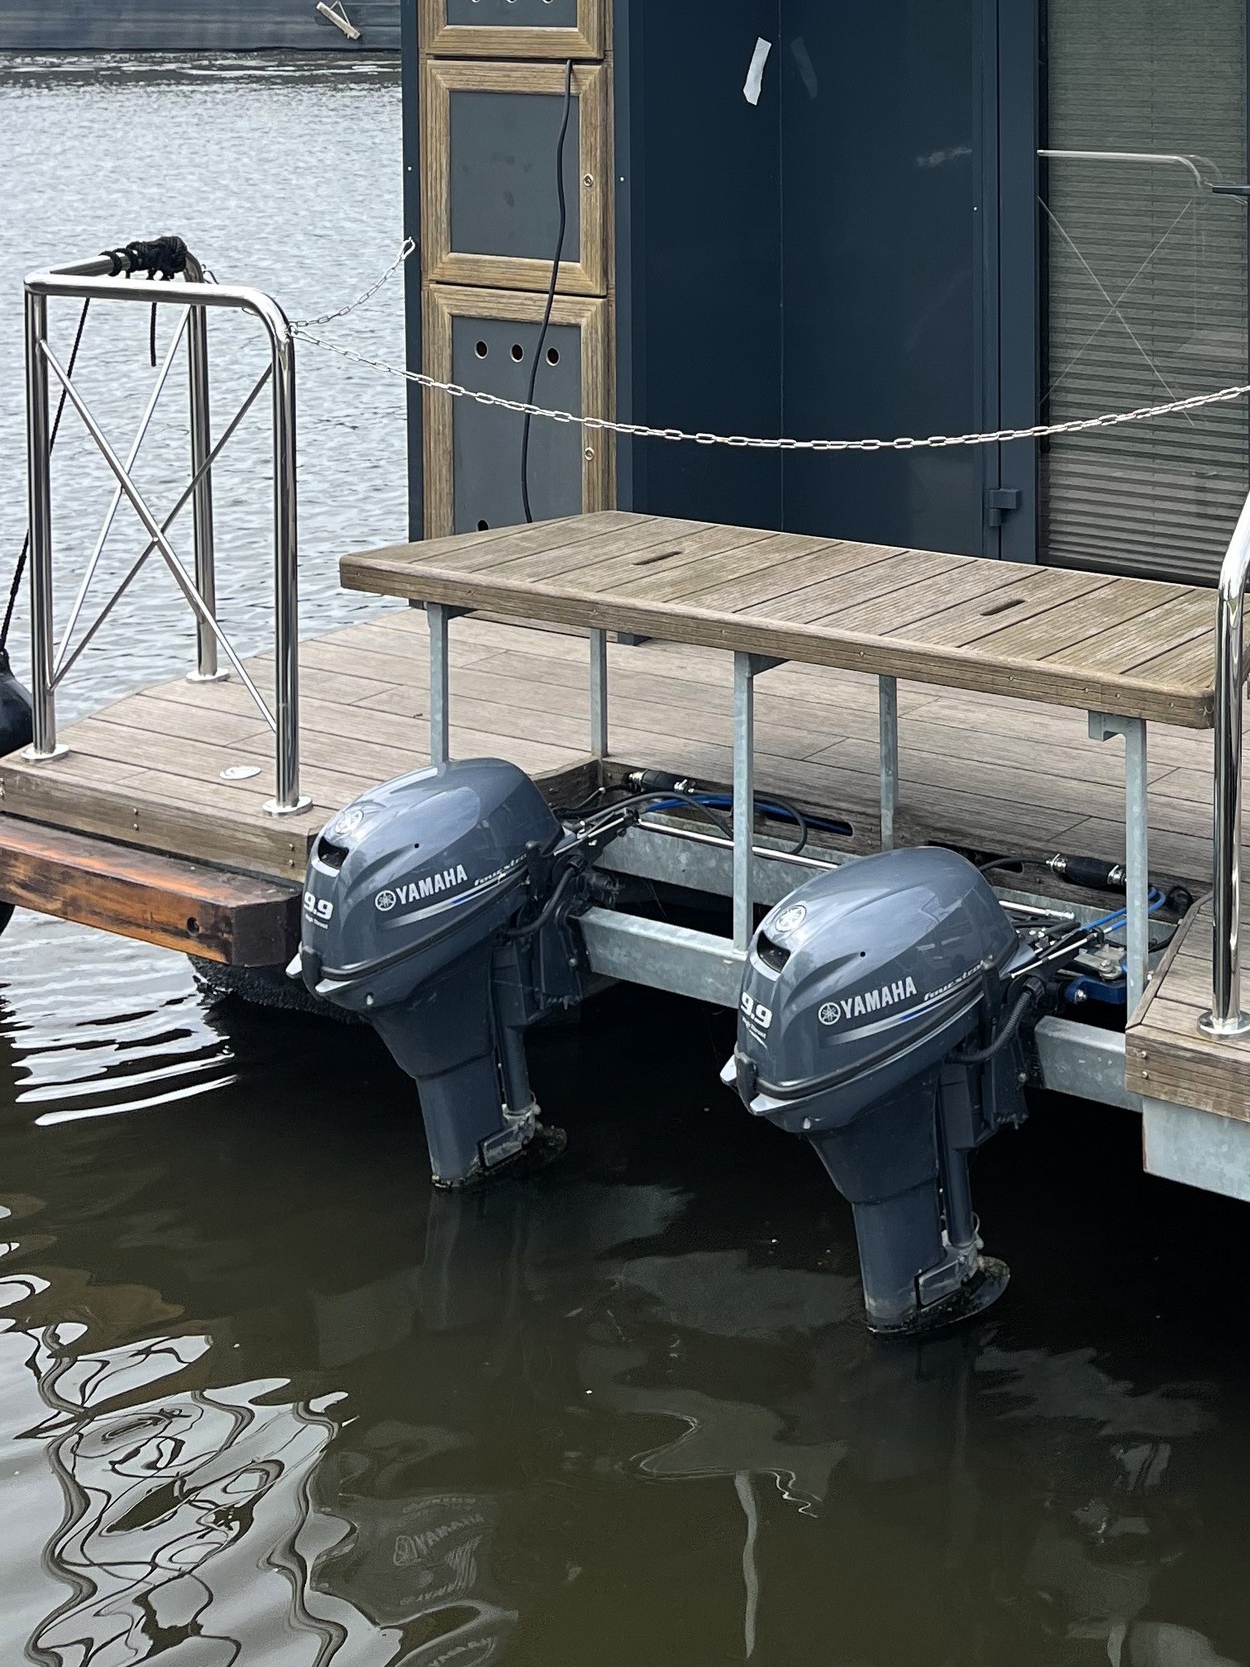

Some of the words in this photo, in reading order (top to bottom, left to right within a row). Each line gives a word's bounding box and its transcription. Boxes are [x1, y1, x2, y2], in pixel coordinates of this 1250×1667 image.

[397, 864, 468, 905] YAMAHA
[304, 891, 334, 920] 9.9
[741, 991, 773, 1028] 9.9
[841, 976, 917, 1019] YAMAHA
